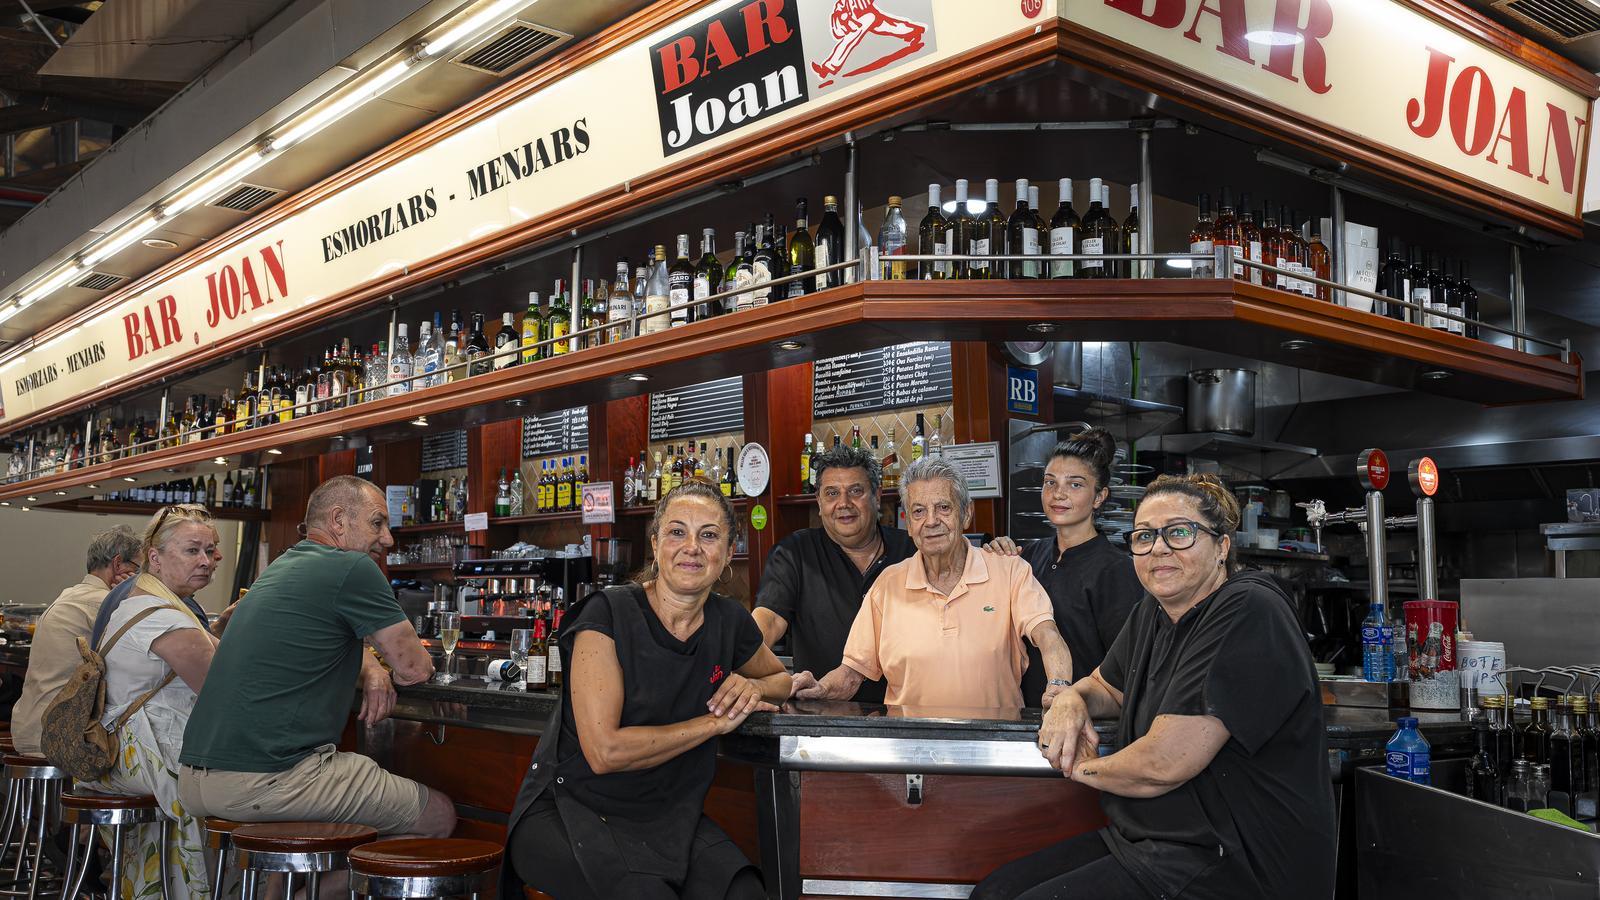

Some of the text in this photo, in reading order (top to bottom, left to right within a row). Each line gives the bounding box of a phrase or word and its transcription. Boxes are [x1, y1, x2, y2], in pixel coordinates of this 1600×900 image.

[657, 0, 793, 93] BAR
[668, 65, 802, 148] Joan
[1406, 45, 1586, 195] JOAN
[320, 187, 437, 263] ESMORZARS
[466, 117, 590, 200] MENJARS
[122, 240, 288, 361] BAR JOAN
[15, 363, 58, 396] ESMORZARS
[66, 341, 106, 375] MENJARS
[1009, 377, 1036, 403] RB
[1461, 656, 1500, 671] BOTE
